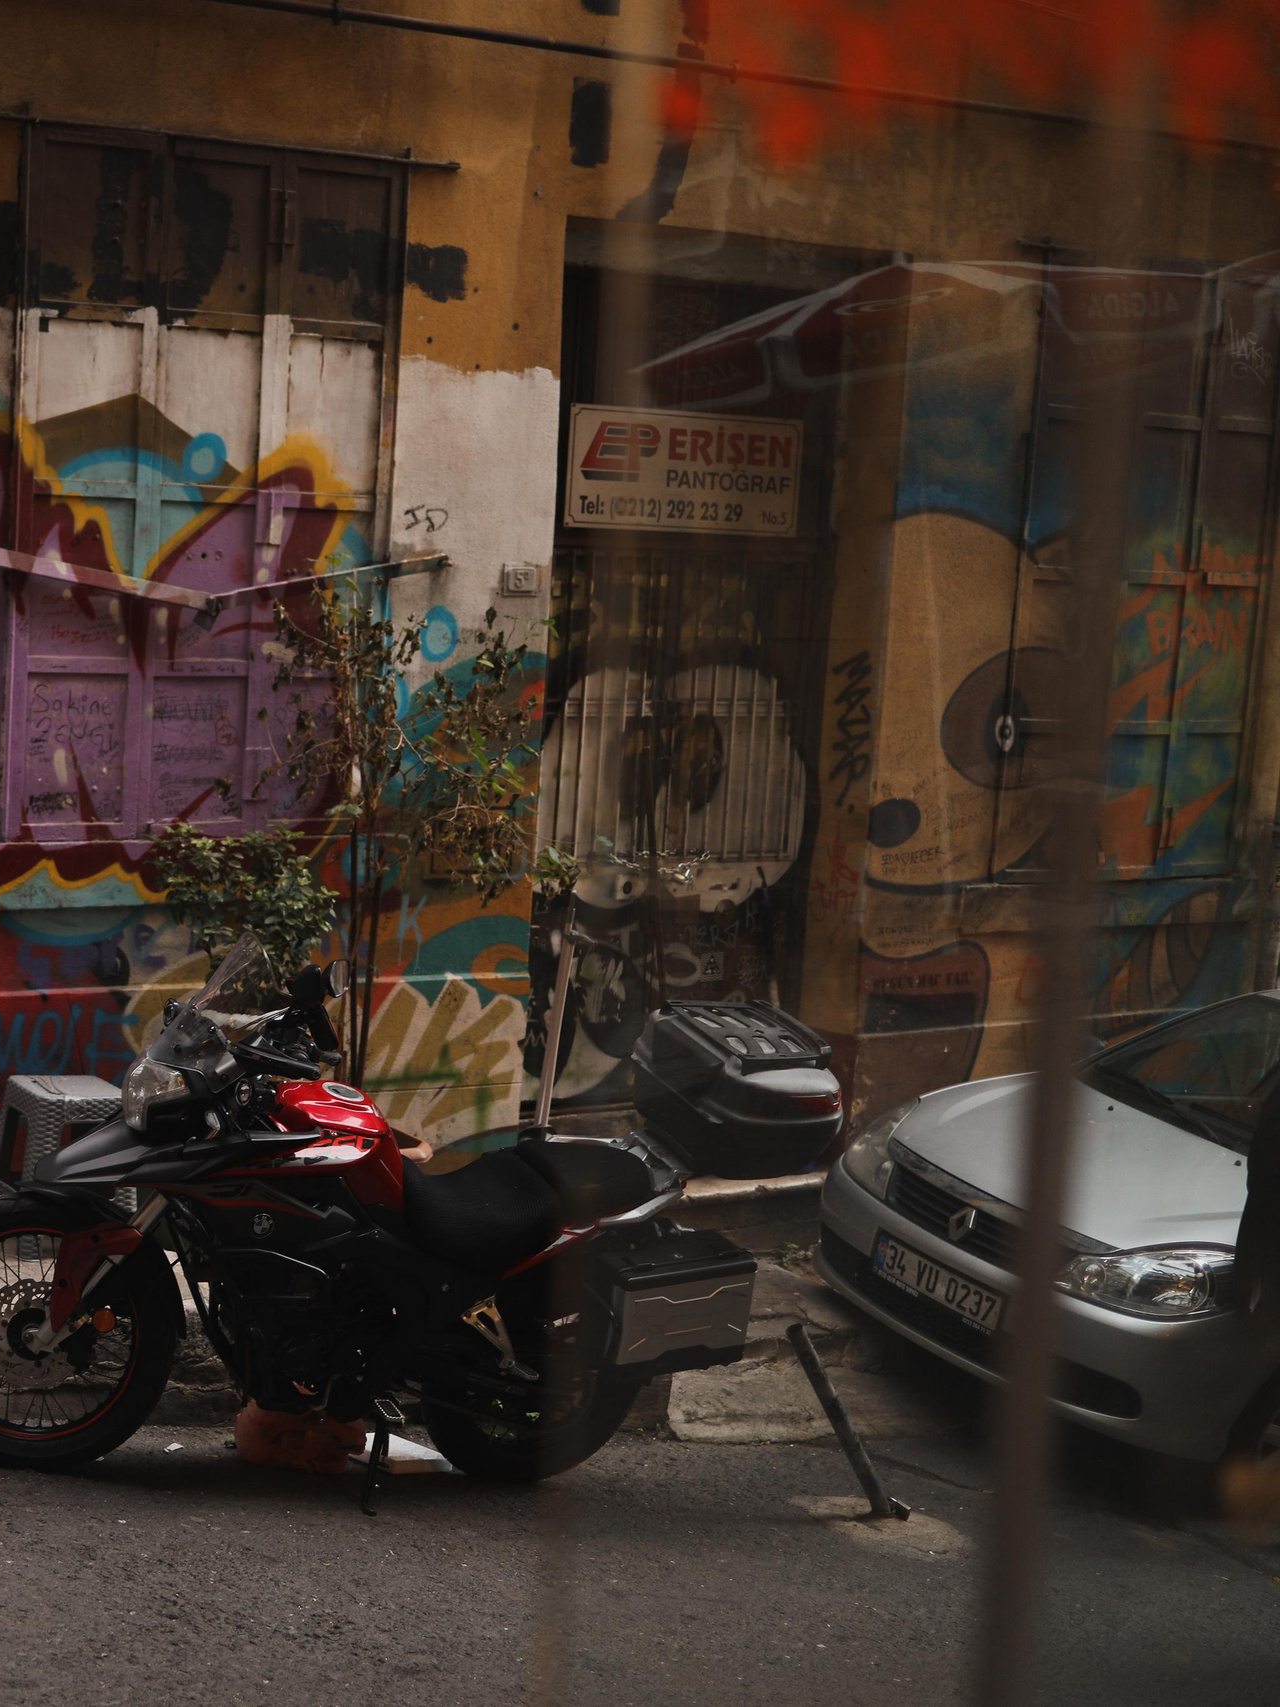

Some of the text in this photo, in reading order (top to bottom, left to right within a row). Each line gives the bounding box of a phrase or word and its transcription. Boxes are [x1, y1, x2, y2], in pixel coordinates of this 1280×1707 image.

[668, 424, 793, 473] ERİŞEN
[666, 469, 791, 495] PANTOĞRAF
[579, 495, 605, 516] Tel:
[667, 499, 695, 521] 292
[700, 501, 719, 521] 23
[723, 503, 743, 522] 29
[762, 510, 787, 526] No.5
[1146, 608, 1247, 655] BRAIN
[885, 1244, 906, 1277] 34
[916, 1260, 940, 1294] VU
[944, 1277, 998, 1321] 0237
